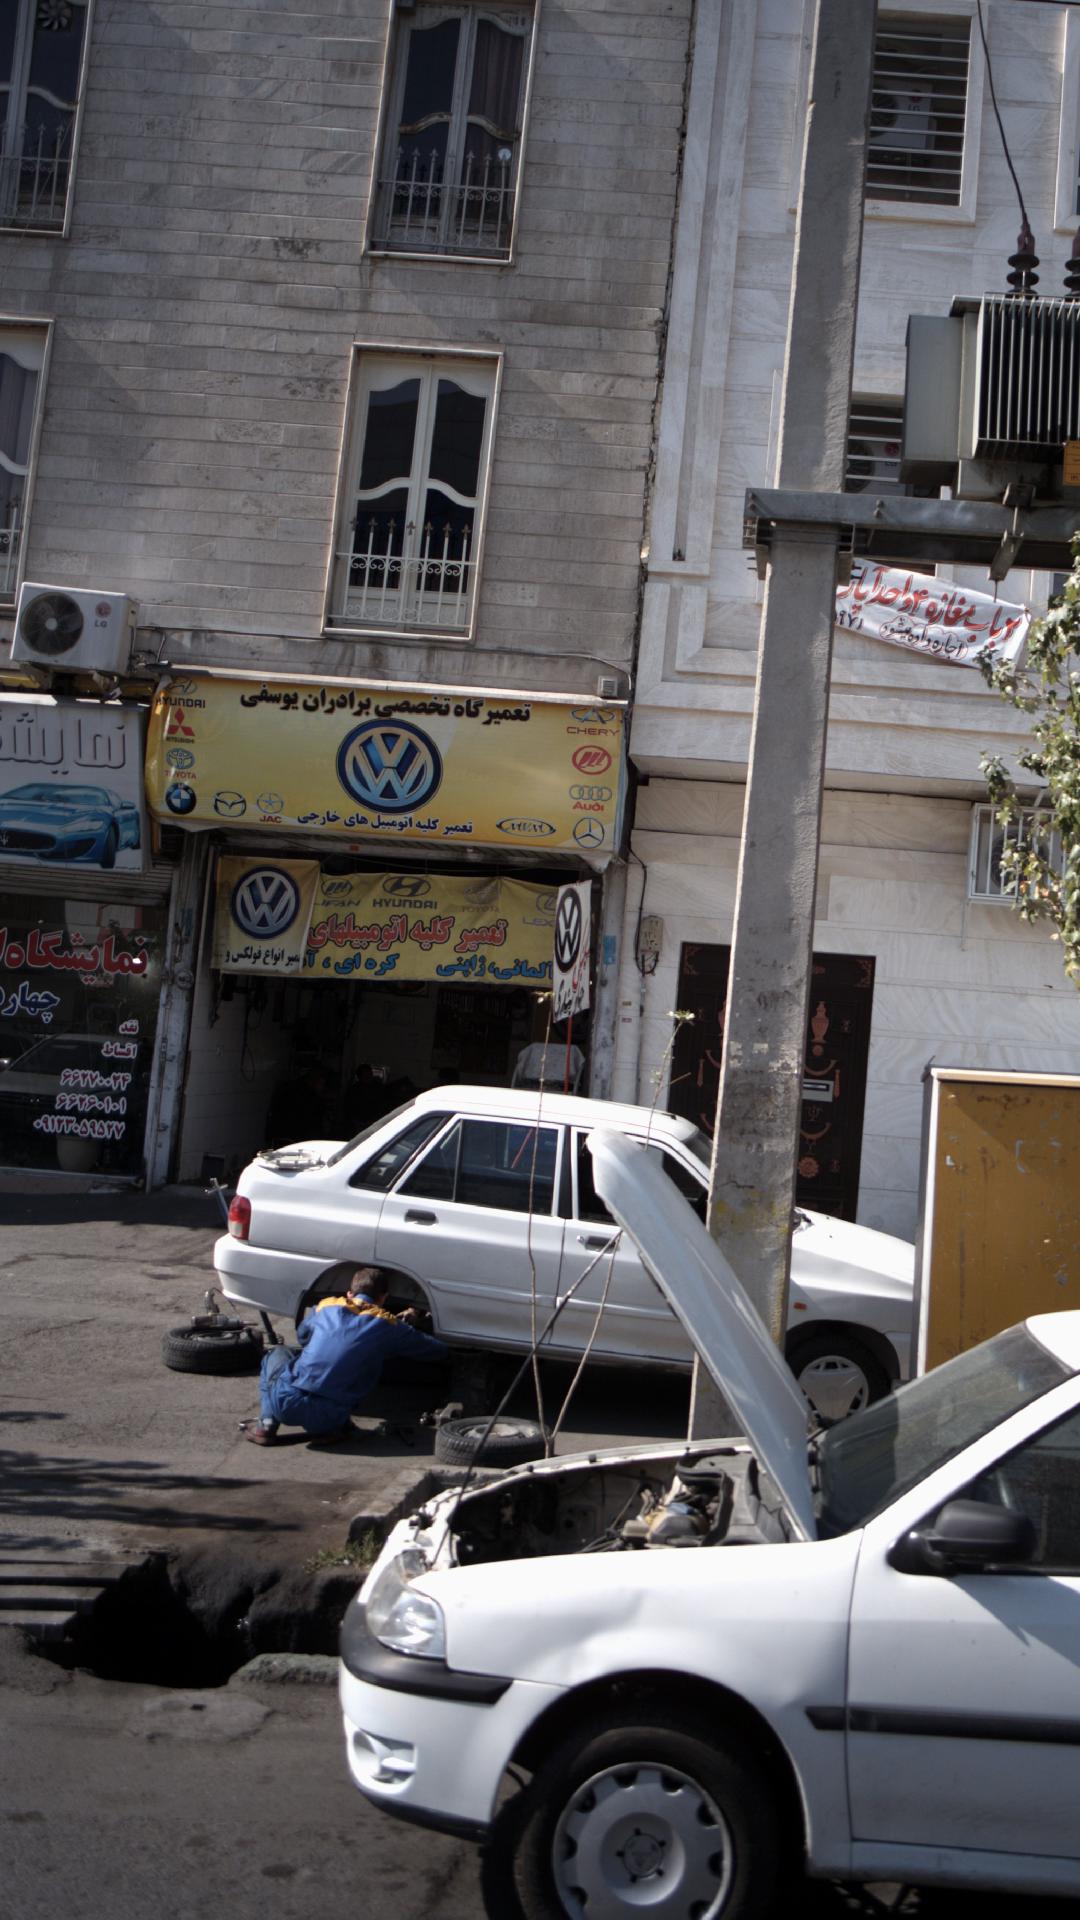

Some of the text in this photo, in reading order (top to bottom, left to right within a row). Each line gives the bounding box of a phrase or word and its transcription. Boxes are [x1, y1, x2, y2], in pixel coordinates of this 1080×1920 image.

[94, 619, 109, 628] LG
[156, 696, 206, 709] HYUNDAI
[240, 683, 299, 711] یوسفی
[300, 687, 371, 717] برادران
[373, 696, 451, 718] تخصصی
[566, 725, 620, 737] CHERY
[0, 711, 126, 776] نمایش
[165, 768, 197, 780] TYOTA
[259, 815, 282, 824] JAC
[297, 810, 472, 835] تعمیر کلیه اتومبیل های خارجی
[372, 898, 437, 909] HYUNDAI
[408, 916, 454, 951] کلیه
[454, 918, 508, 952] تعمیر
[4, 928, 149, 985] نمایشگاه
[263, 948, 284, 965] انواع
[365, 953, 400, 976] کره
[436, 954, 486, 977] ژاپنی
[119, 1019, 139, 1035] نقد
[101, 1041, 137, 1059] اقساط
